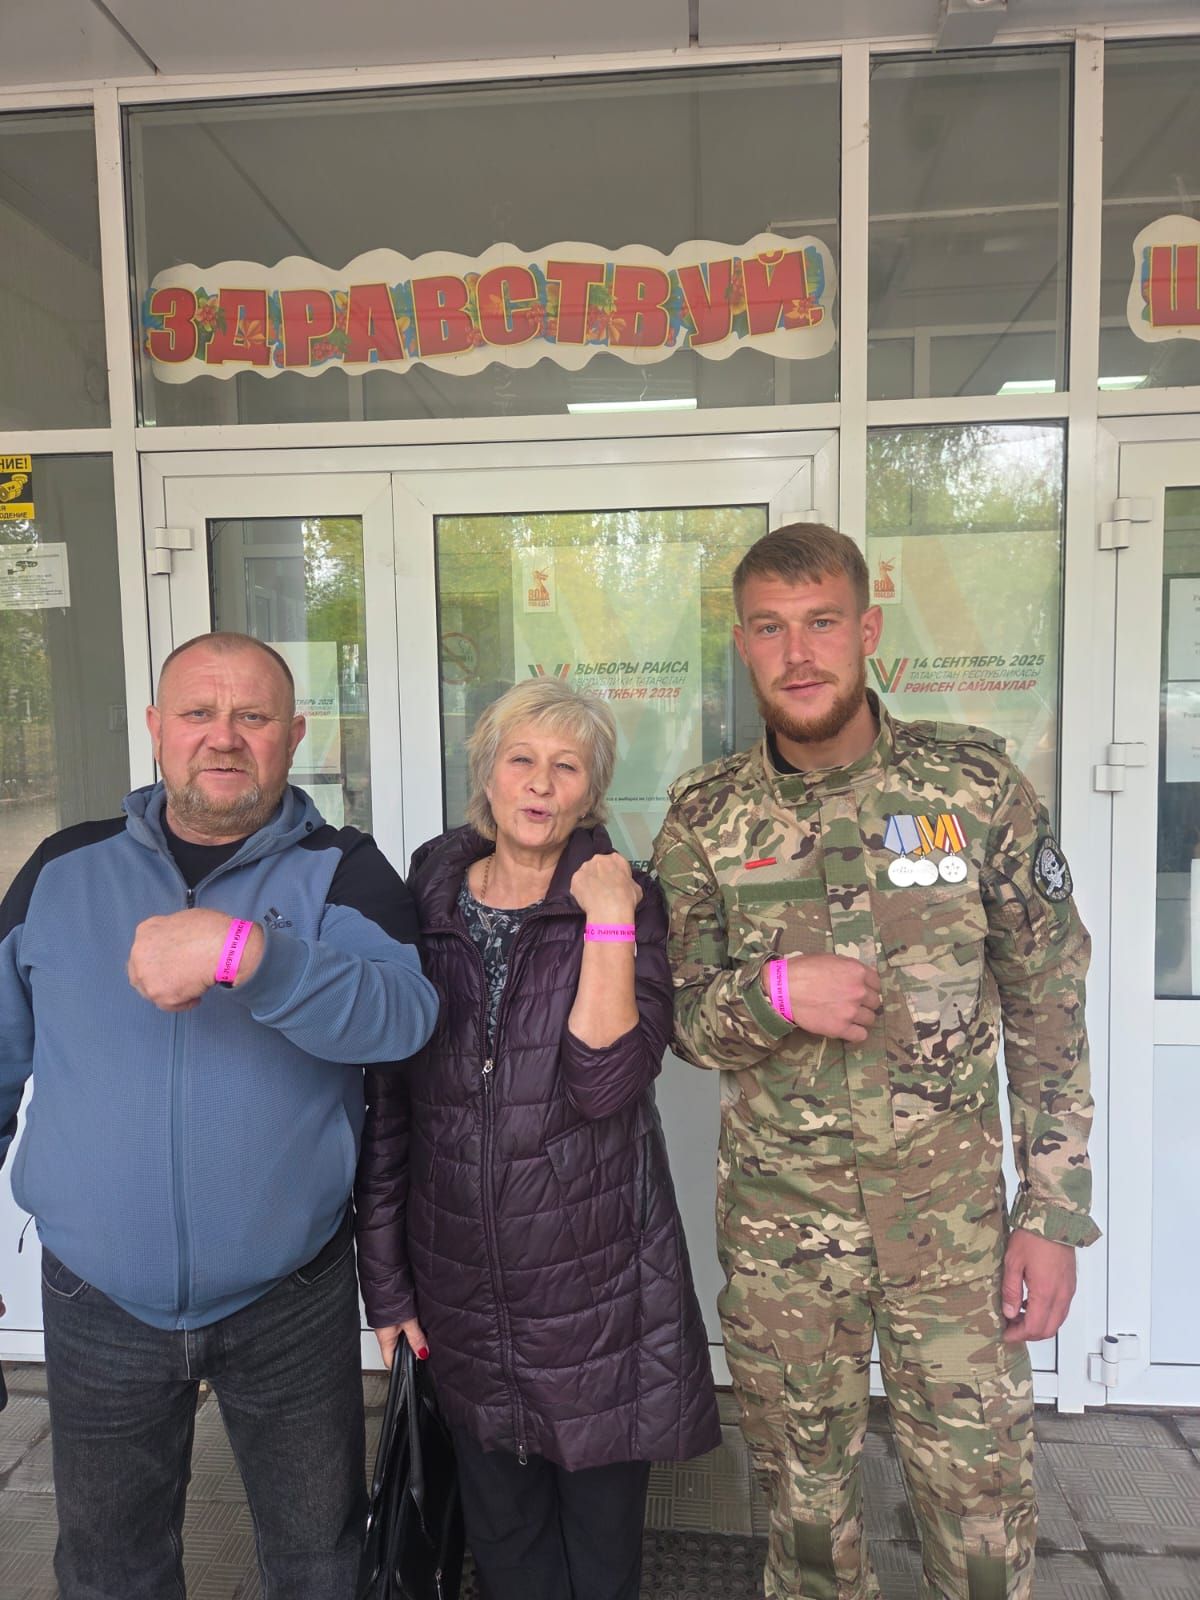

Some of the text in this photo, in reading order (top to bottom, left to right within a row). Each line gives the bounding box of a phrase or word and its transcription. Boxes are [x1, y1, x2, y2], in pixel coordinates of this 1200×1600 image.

[575, 661, 689, 675] ВЫБОРЫ РАИСА
[912, 655, 1045, 669] 14 СЕНТЯБРЬ 2025
[957, 679, 1037, 692] САЙЛАУЛАР
[649, 687, 682, 698] 2025
